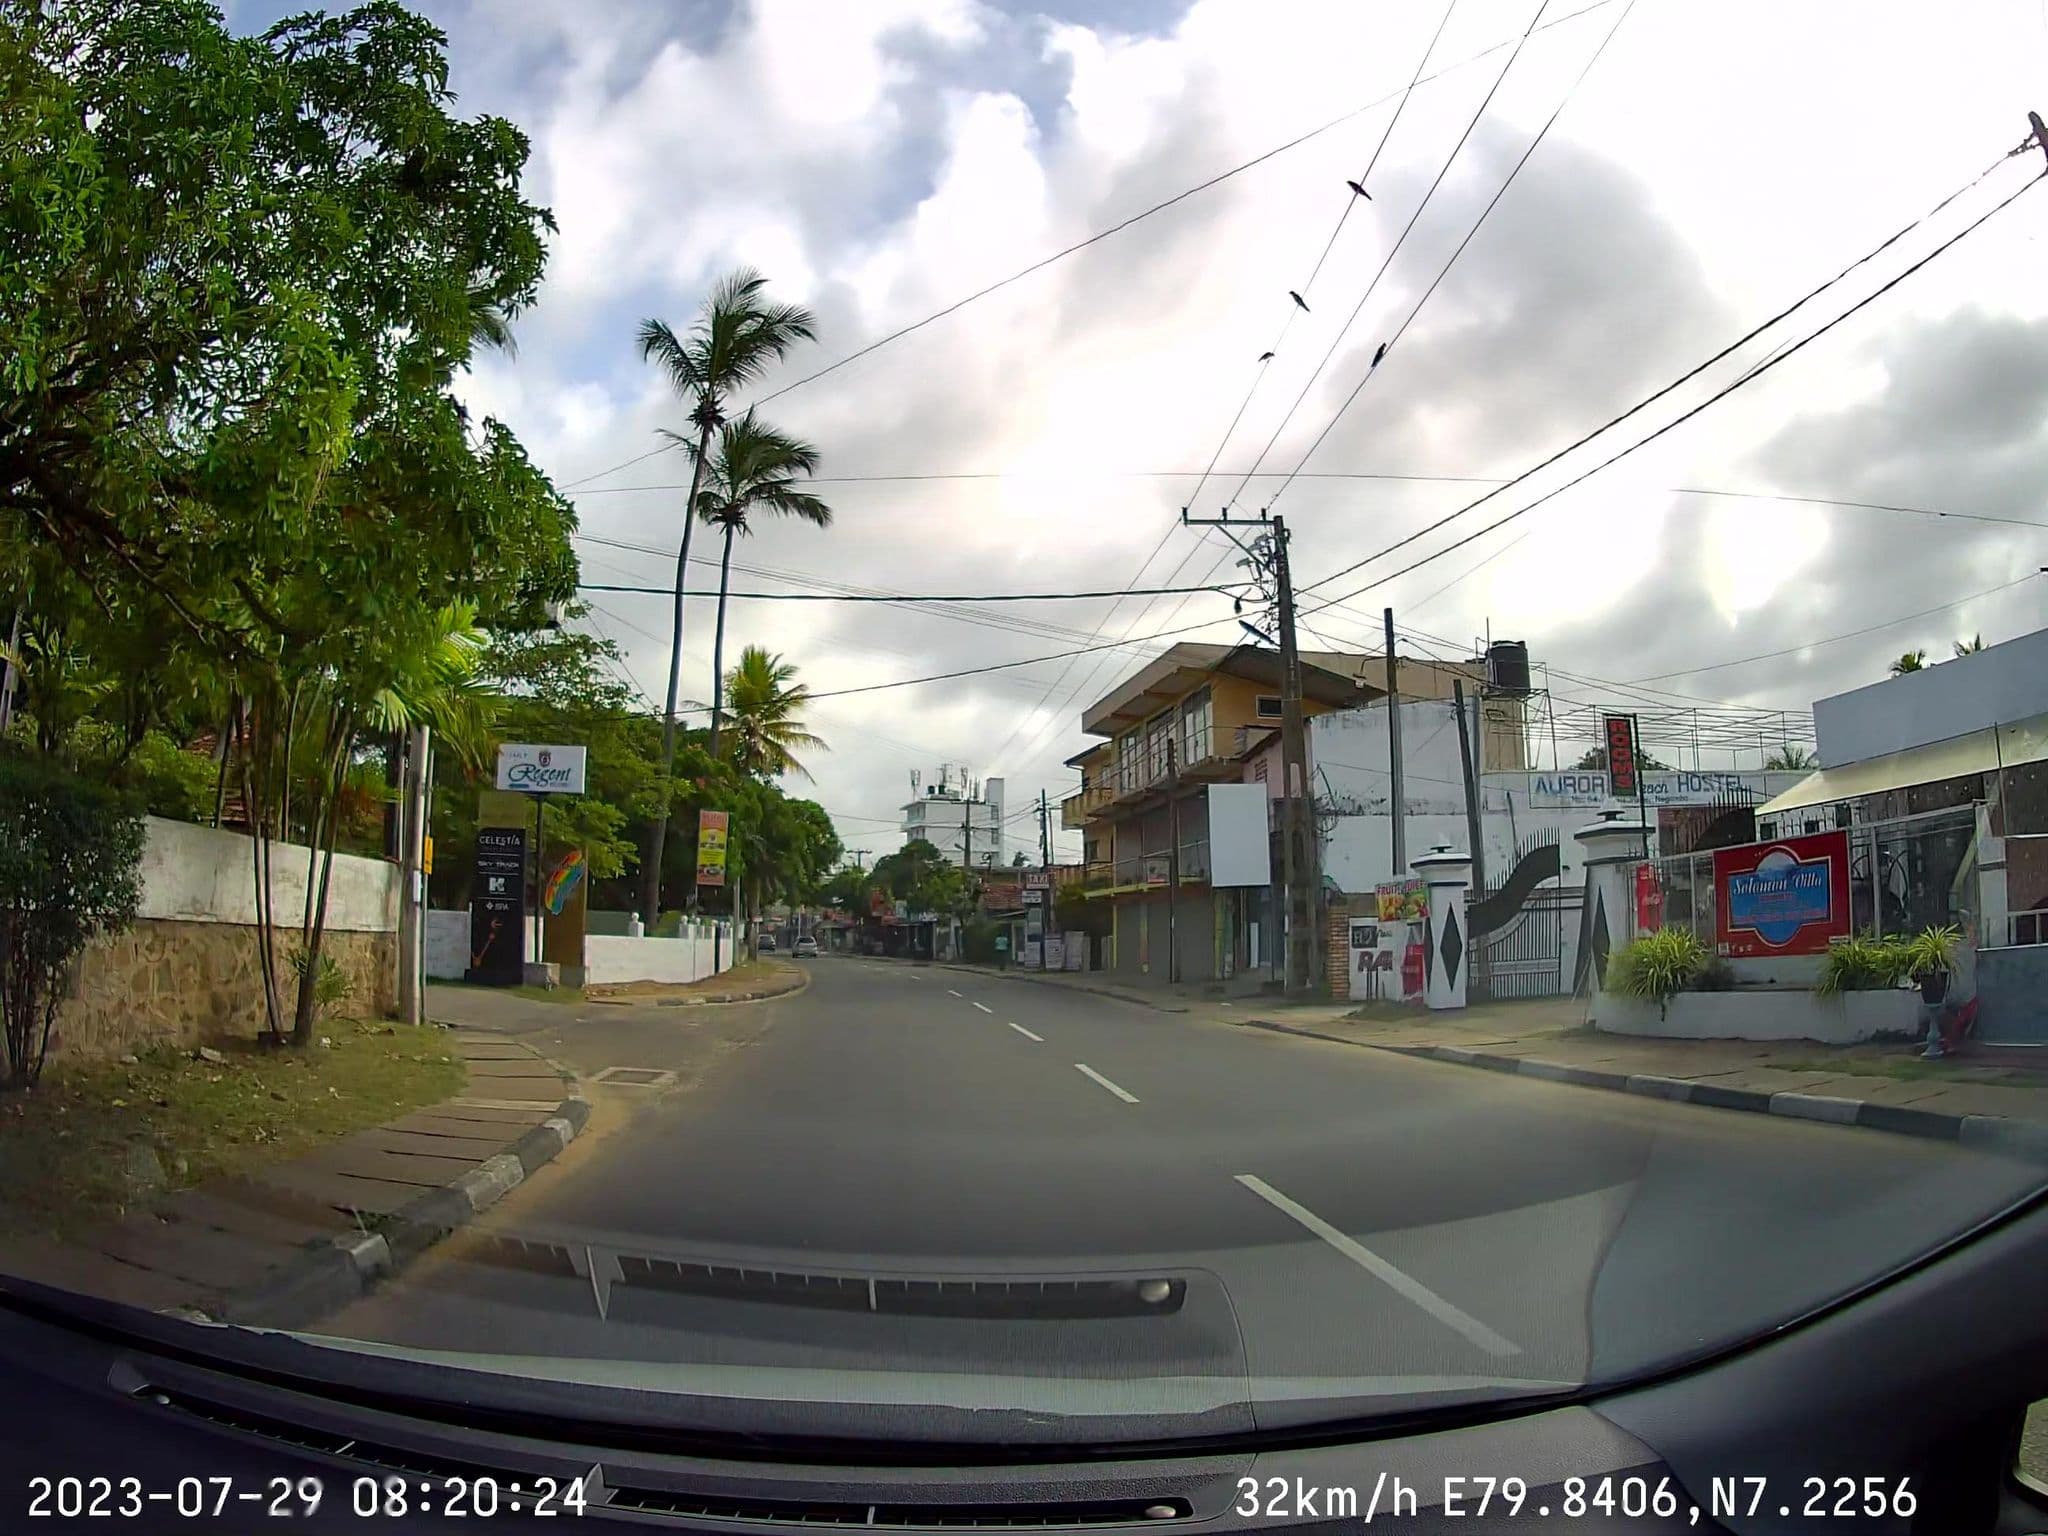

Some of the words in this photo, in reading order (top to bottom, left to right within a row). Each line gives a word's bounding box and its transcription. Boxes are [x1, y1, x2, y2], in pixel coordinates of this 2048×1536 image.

[1609, 720, 1634, 789] ROOMS
[508, 763, 571, 787] Regent
[1536, 774, 1605, 794] AUROR
[1677, 774, 1743, 793] HOSTEL
[479, 834, 521, 847] CELESTIA
